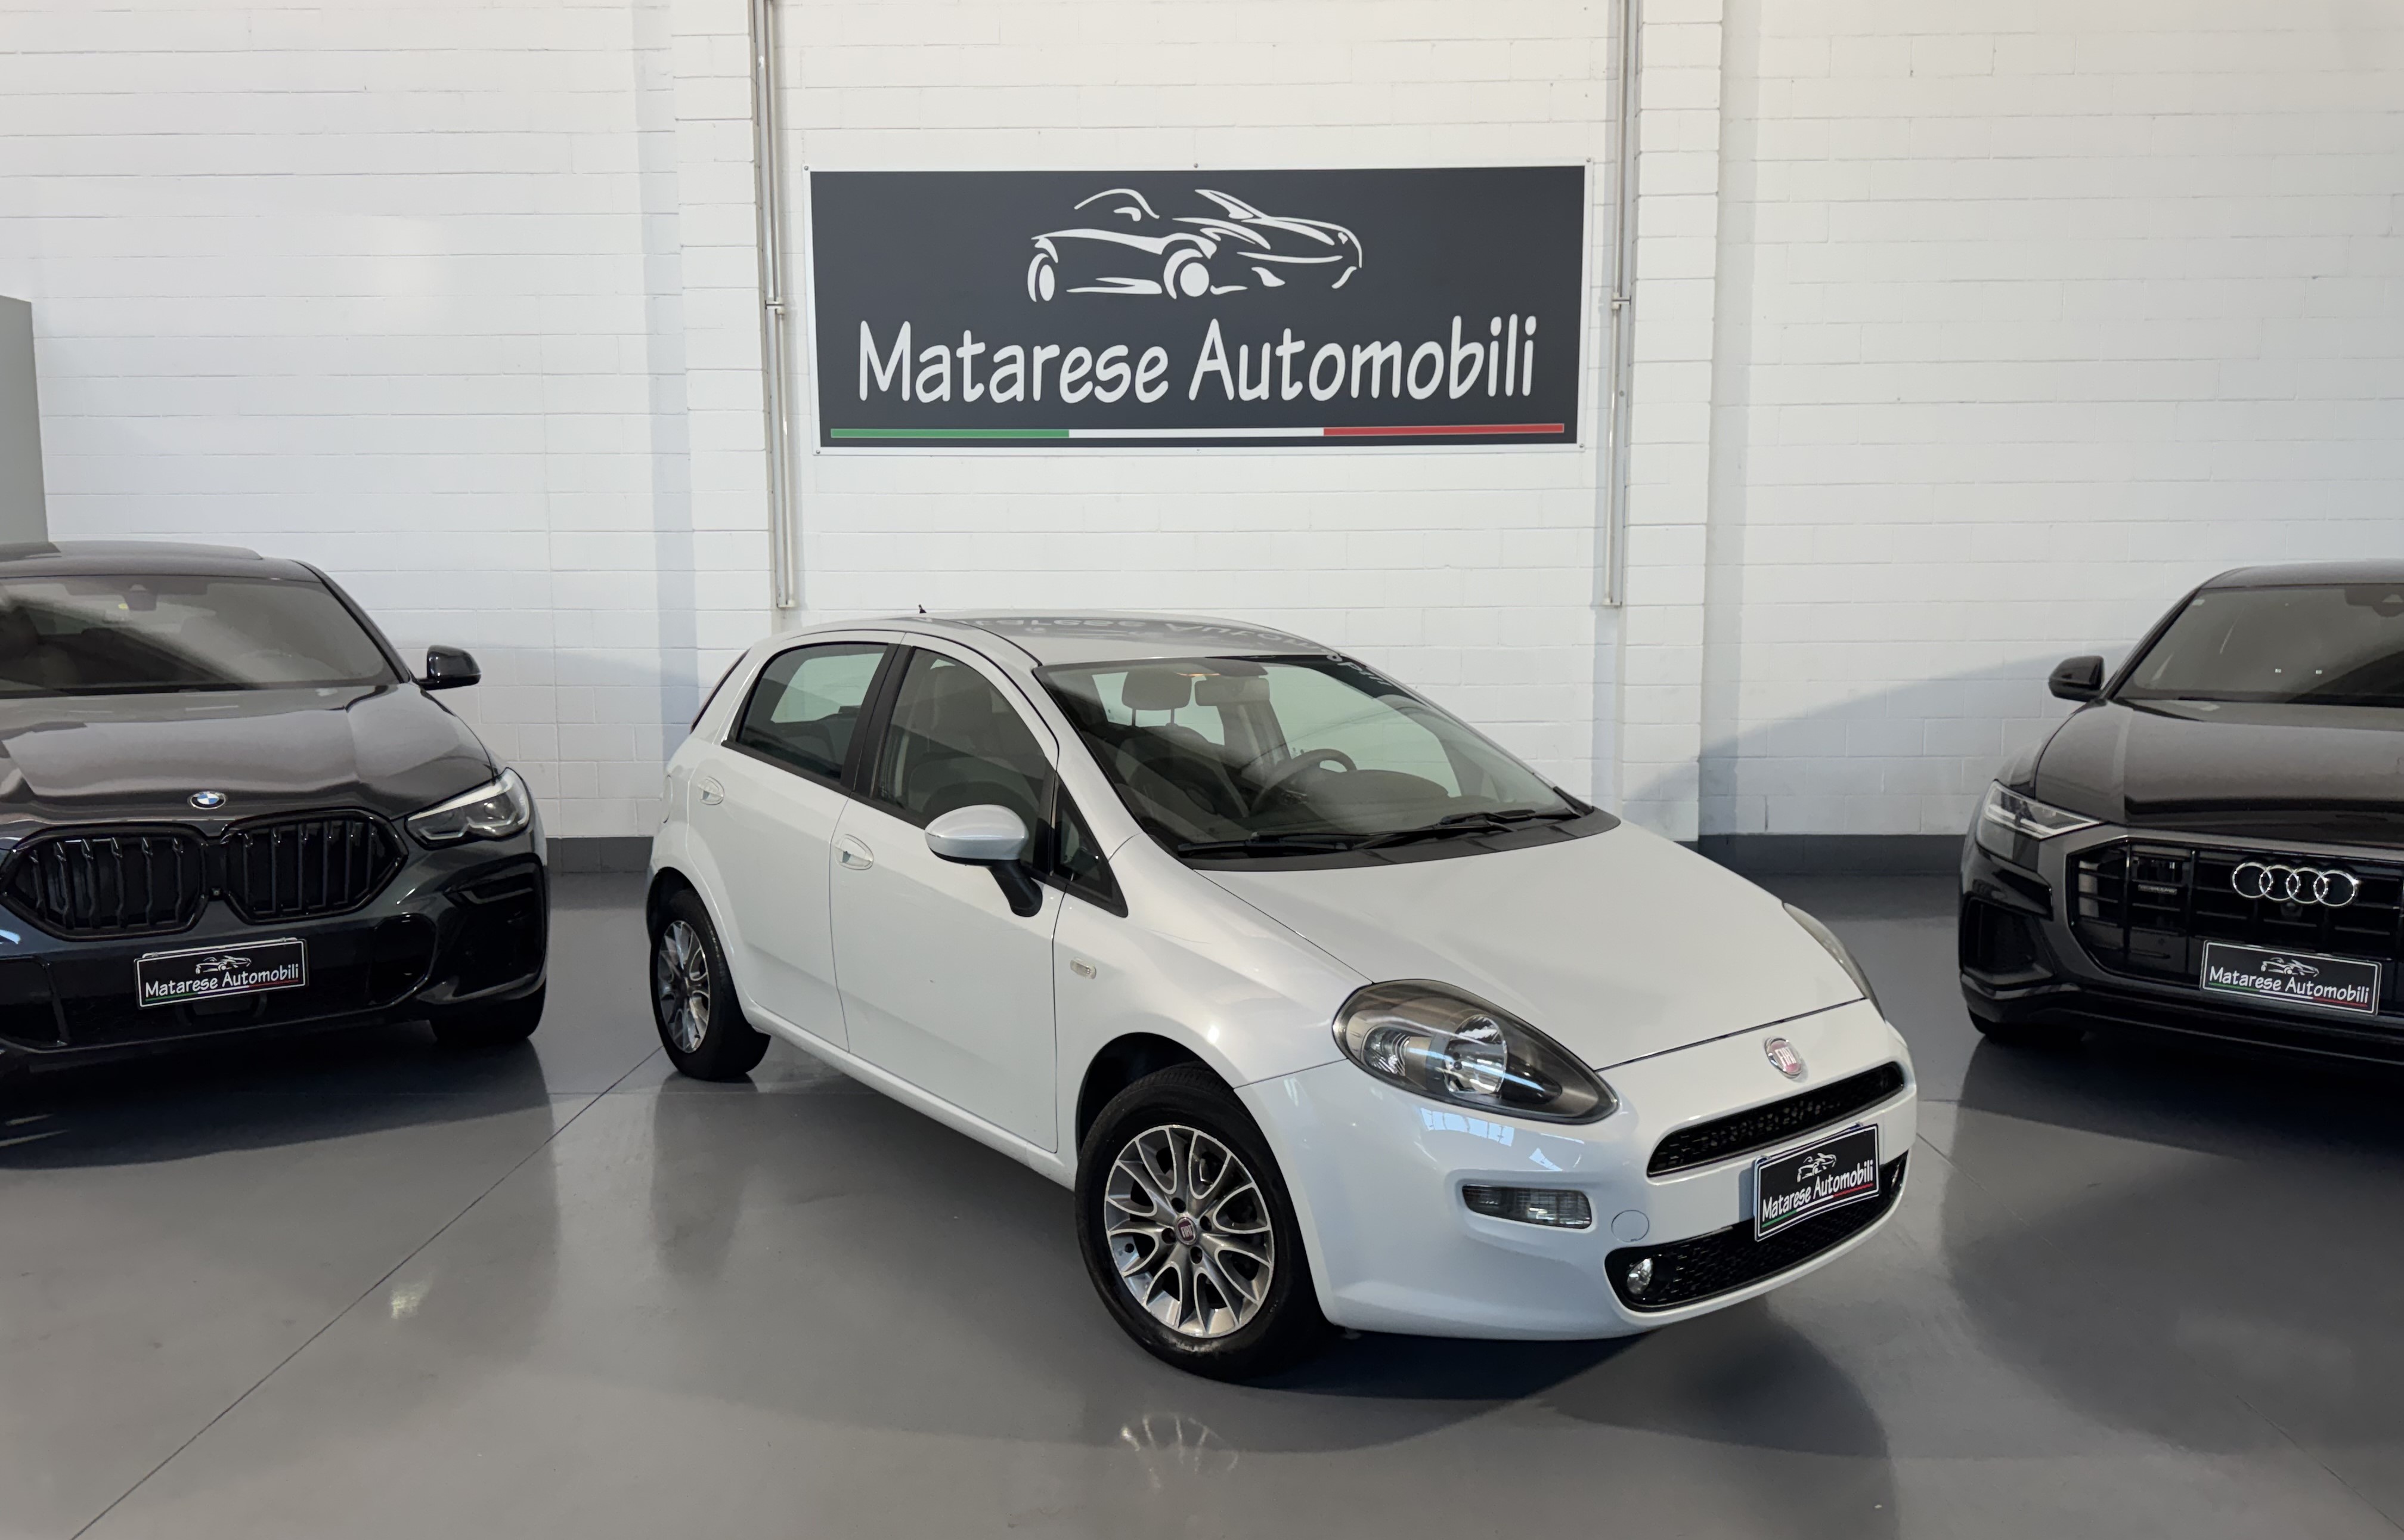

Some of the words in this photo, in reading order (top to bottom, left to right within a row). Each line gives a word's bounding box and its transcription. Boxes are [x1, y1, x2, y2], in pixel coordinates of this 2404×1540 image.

[859, 320, 1169, 404] Matarese
[1188, 314, 1537, 401] Automobili
[145, 977, 218, 997] Matarese
[222, 963, 299, 987] Automobili
[2209, 965, 2282, 991] Matarese
[2285, 977, 2369, 1003] Automobili
[1762, 1186, 1811, 1222] Matarese
[1813, 1160, 1873, 1200] Automobili
